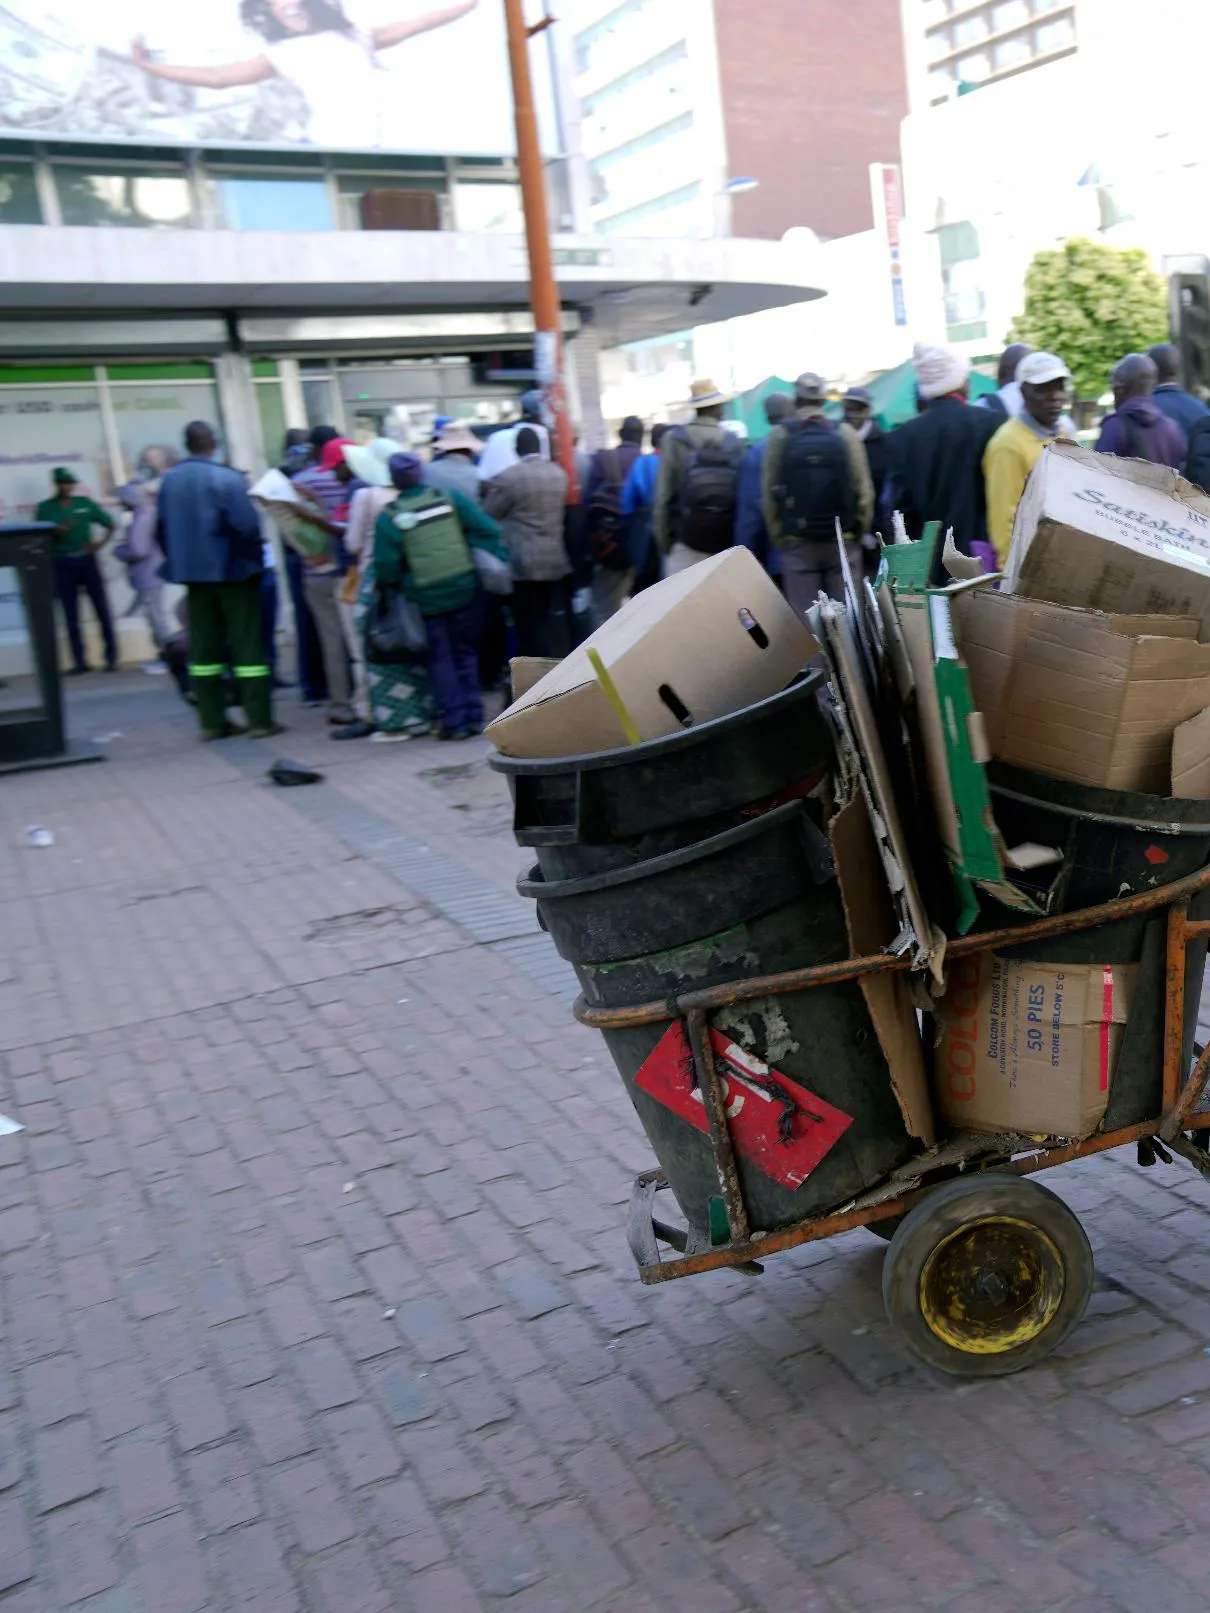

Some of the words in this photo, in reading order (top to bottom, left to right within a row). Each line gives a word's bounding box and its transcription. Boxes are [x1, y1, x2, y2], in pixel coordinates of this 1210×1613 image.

[1095, 509, 1151, 537] BUBBLE
[1153, 533, 1190, 551] BATH
[1012, 975, 1025, 1020] Something
[1027, 984, 1045, 1023] PIES
[1052, 993, 1062, 1030] BELOW
[946, 956, 980, 1102] COLCO
[1027, 1028, 1043, 1051] 50
[1051, 1033, 1060, 1067] STORE
